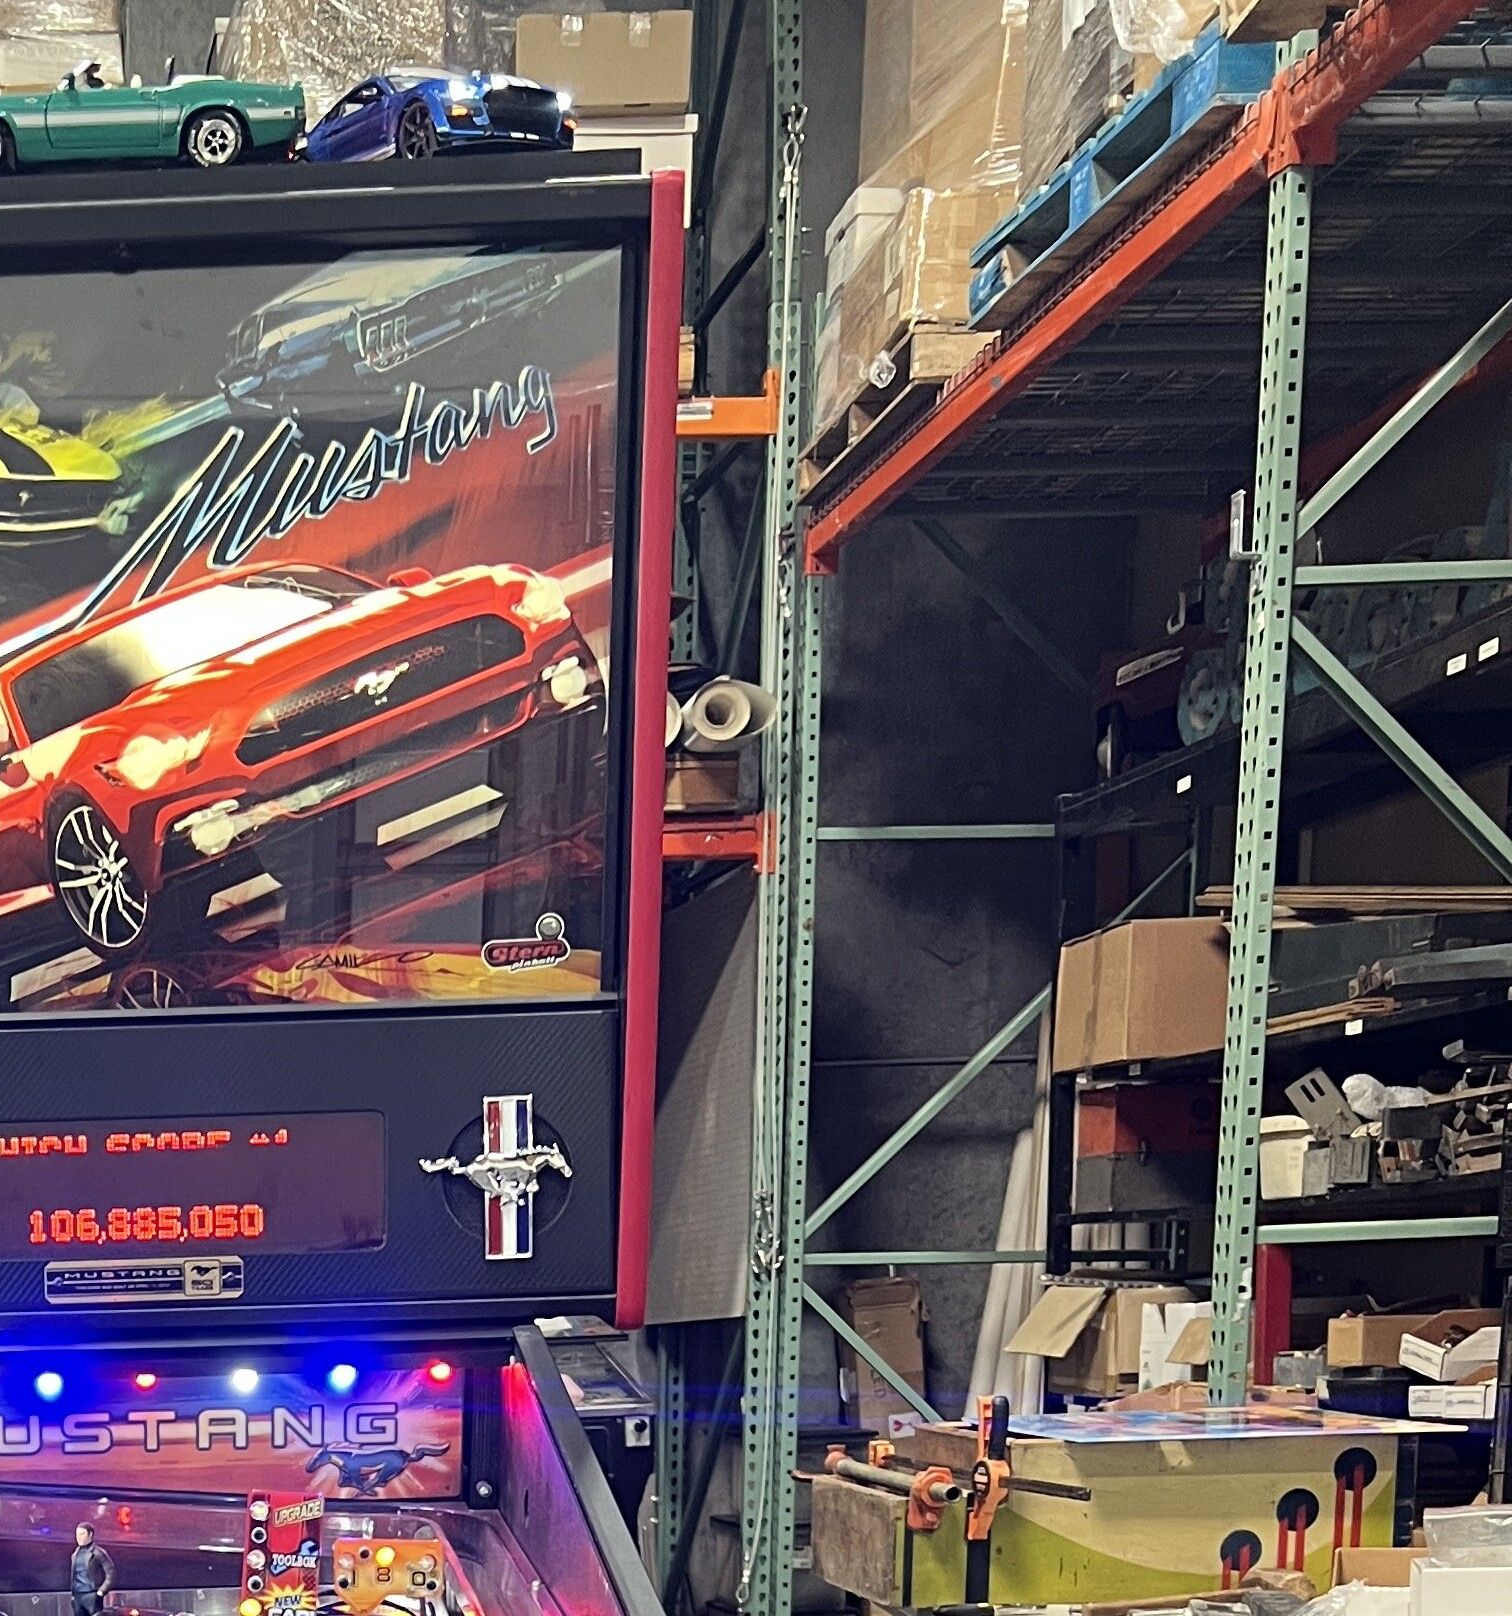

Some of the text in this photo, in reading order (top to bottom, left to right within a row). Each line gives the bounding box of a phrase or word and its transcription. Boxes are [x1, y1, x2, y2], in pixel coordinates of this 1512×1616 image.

[100, 364, 557, 608] Mustang
[490, 941, 564, 963] Stern
[29, 1203, 264, 1244] 106,885,050
[63, 1268, 181, 1280] MUSTANG
[274, 1501, 323, 1526] UPGRADE
[272, 1553, 316, 1568] TOOLBOX
[274, 1594, 302, 1607] NEW
